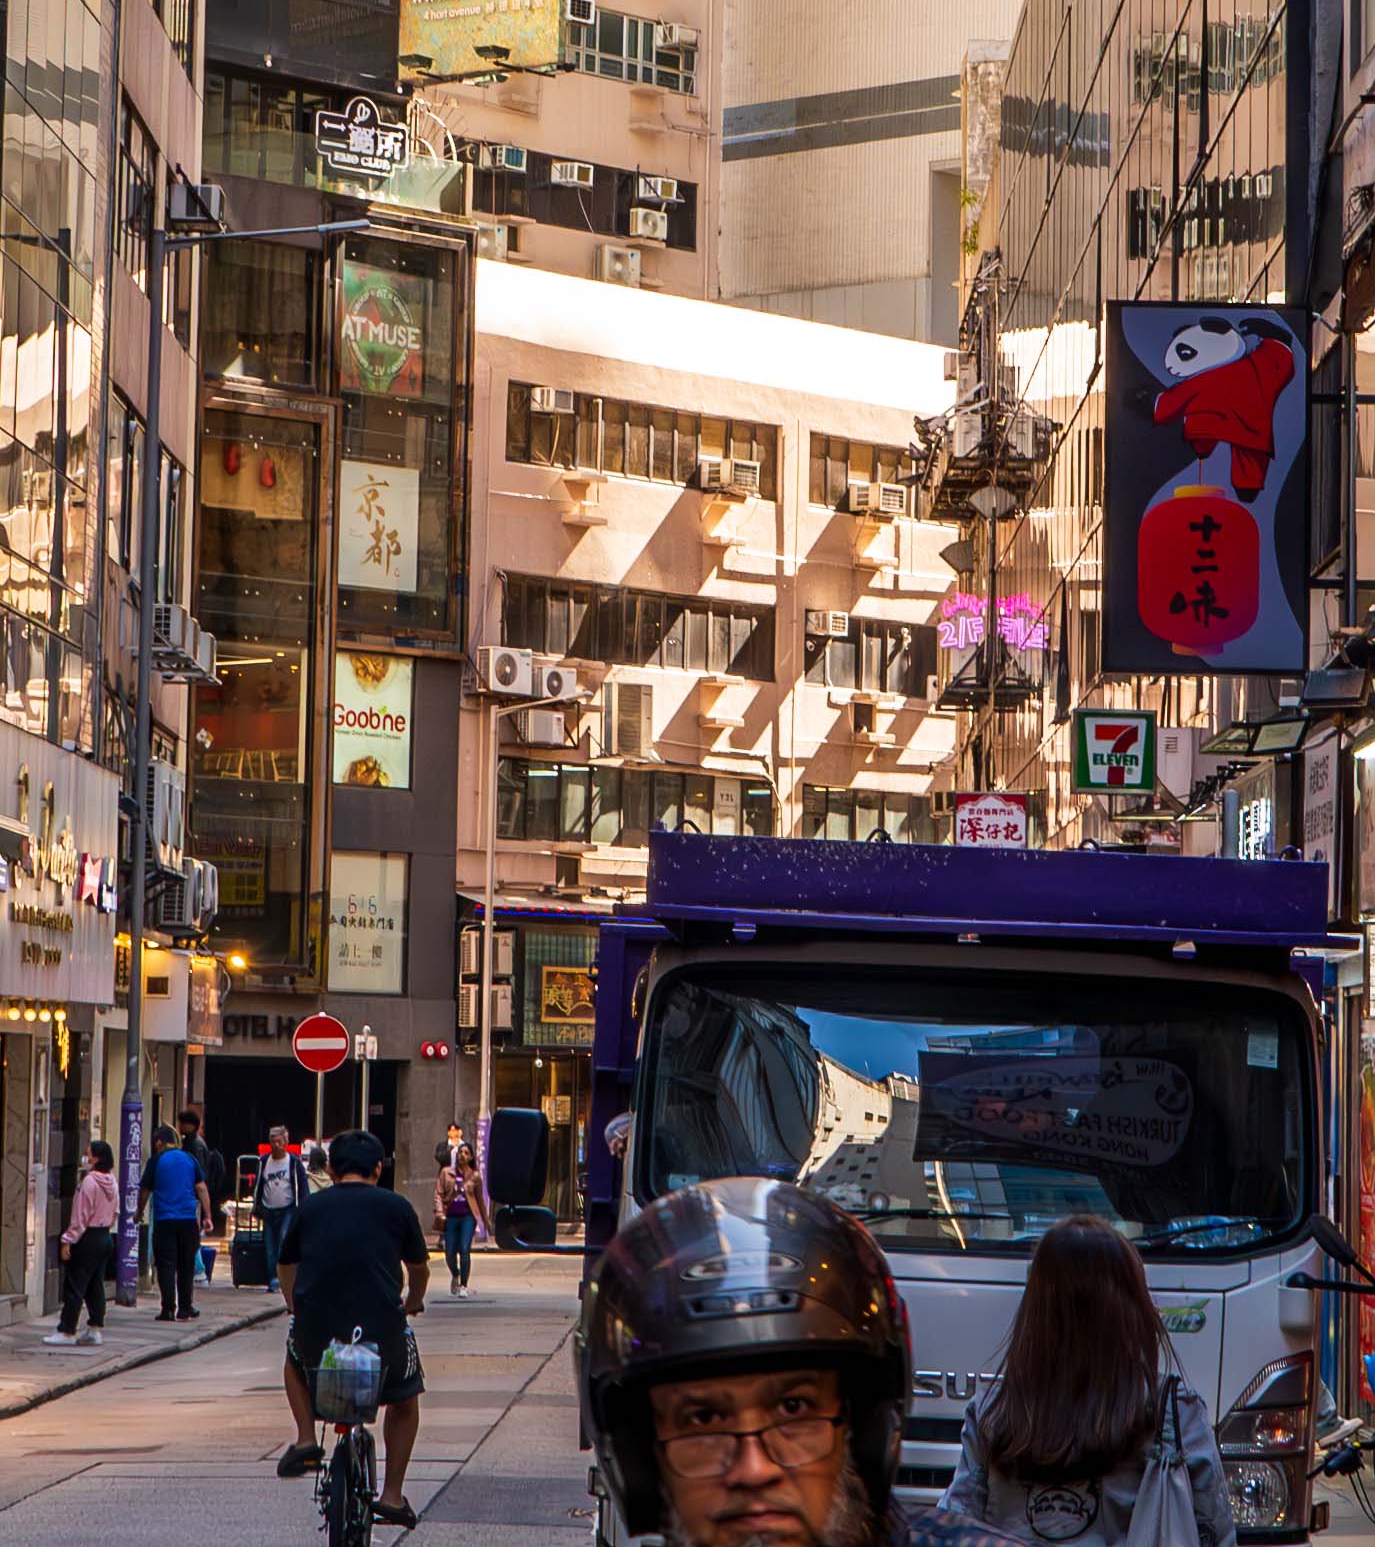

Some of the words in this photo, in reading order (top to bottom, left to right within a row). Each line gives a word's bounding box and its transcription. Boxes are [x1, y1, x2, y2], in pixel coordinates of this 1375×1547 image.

[361, 157, 390, 170] CLUB
[342, 314, 368, 341] AT
[368, 321, 421, 350] MUSE
[352, 474, 402, 577] 京都
[1169, 515, 1230, 629] 十二味
[938, 617, 984, 649] 2/F
[1095, 724, 1139, 786] 7
